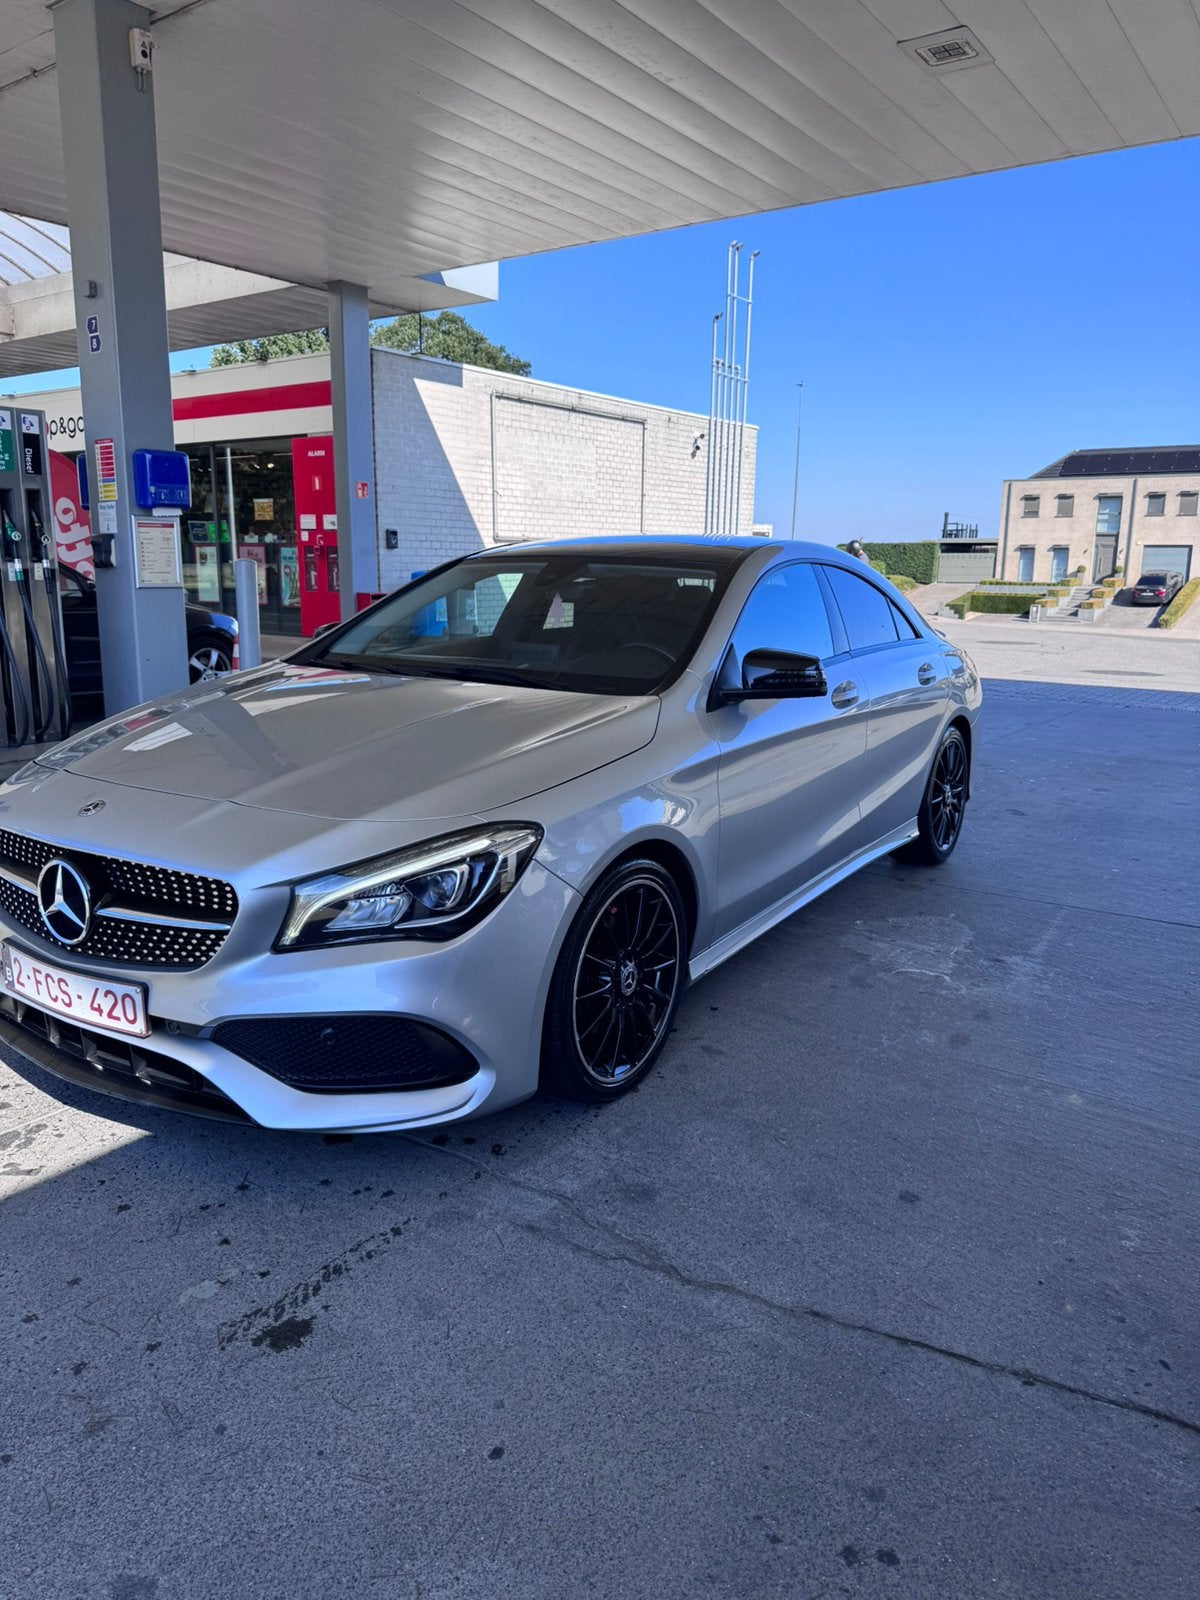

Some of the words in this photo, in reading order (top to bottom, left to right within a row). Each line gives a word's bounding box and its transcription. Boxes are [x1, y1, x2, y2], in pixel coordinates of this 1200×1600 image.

[91, 320, 96, 330] 7
[92, 338, 97, 349] 8
[46, 416, 84, 440] p&go
[25, 447, 35, 474] Diesel
[6, 968, 13, 981] B
[13, 957, 138, 1025] 2-FCS-420
